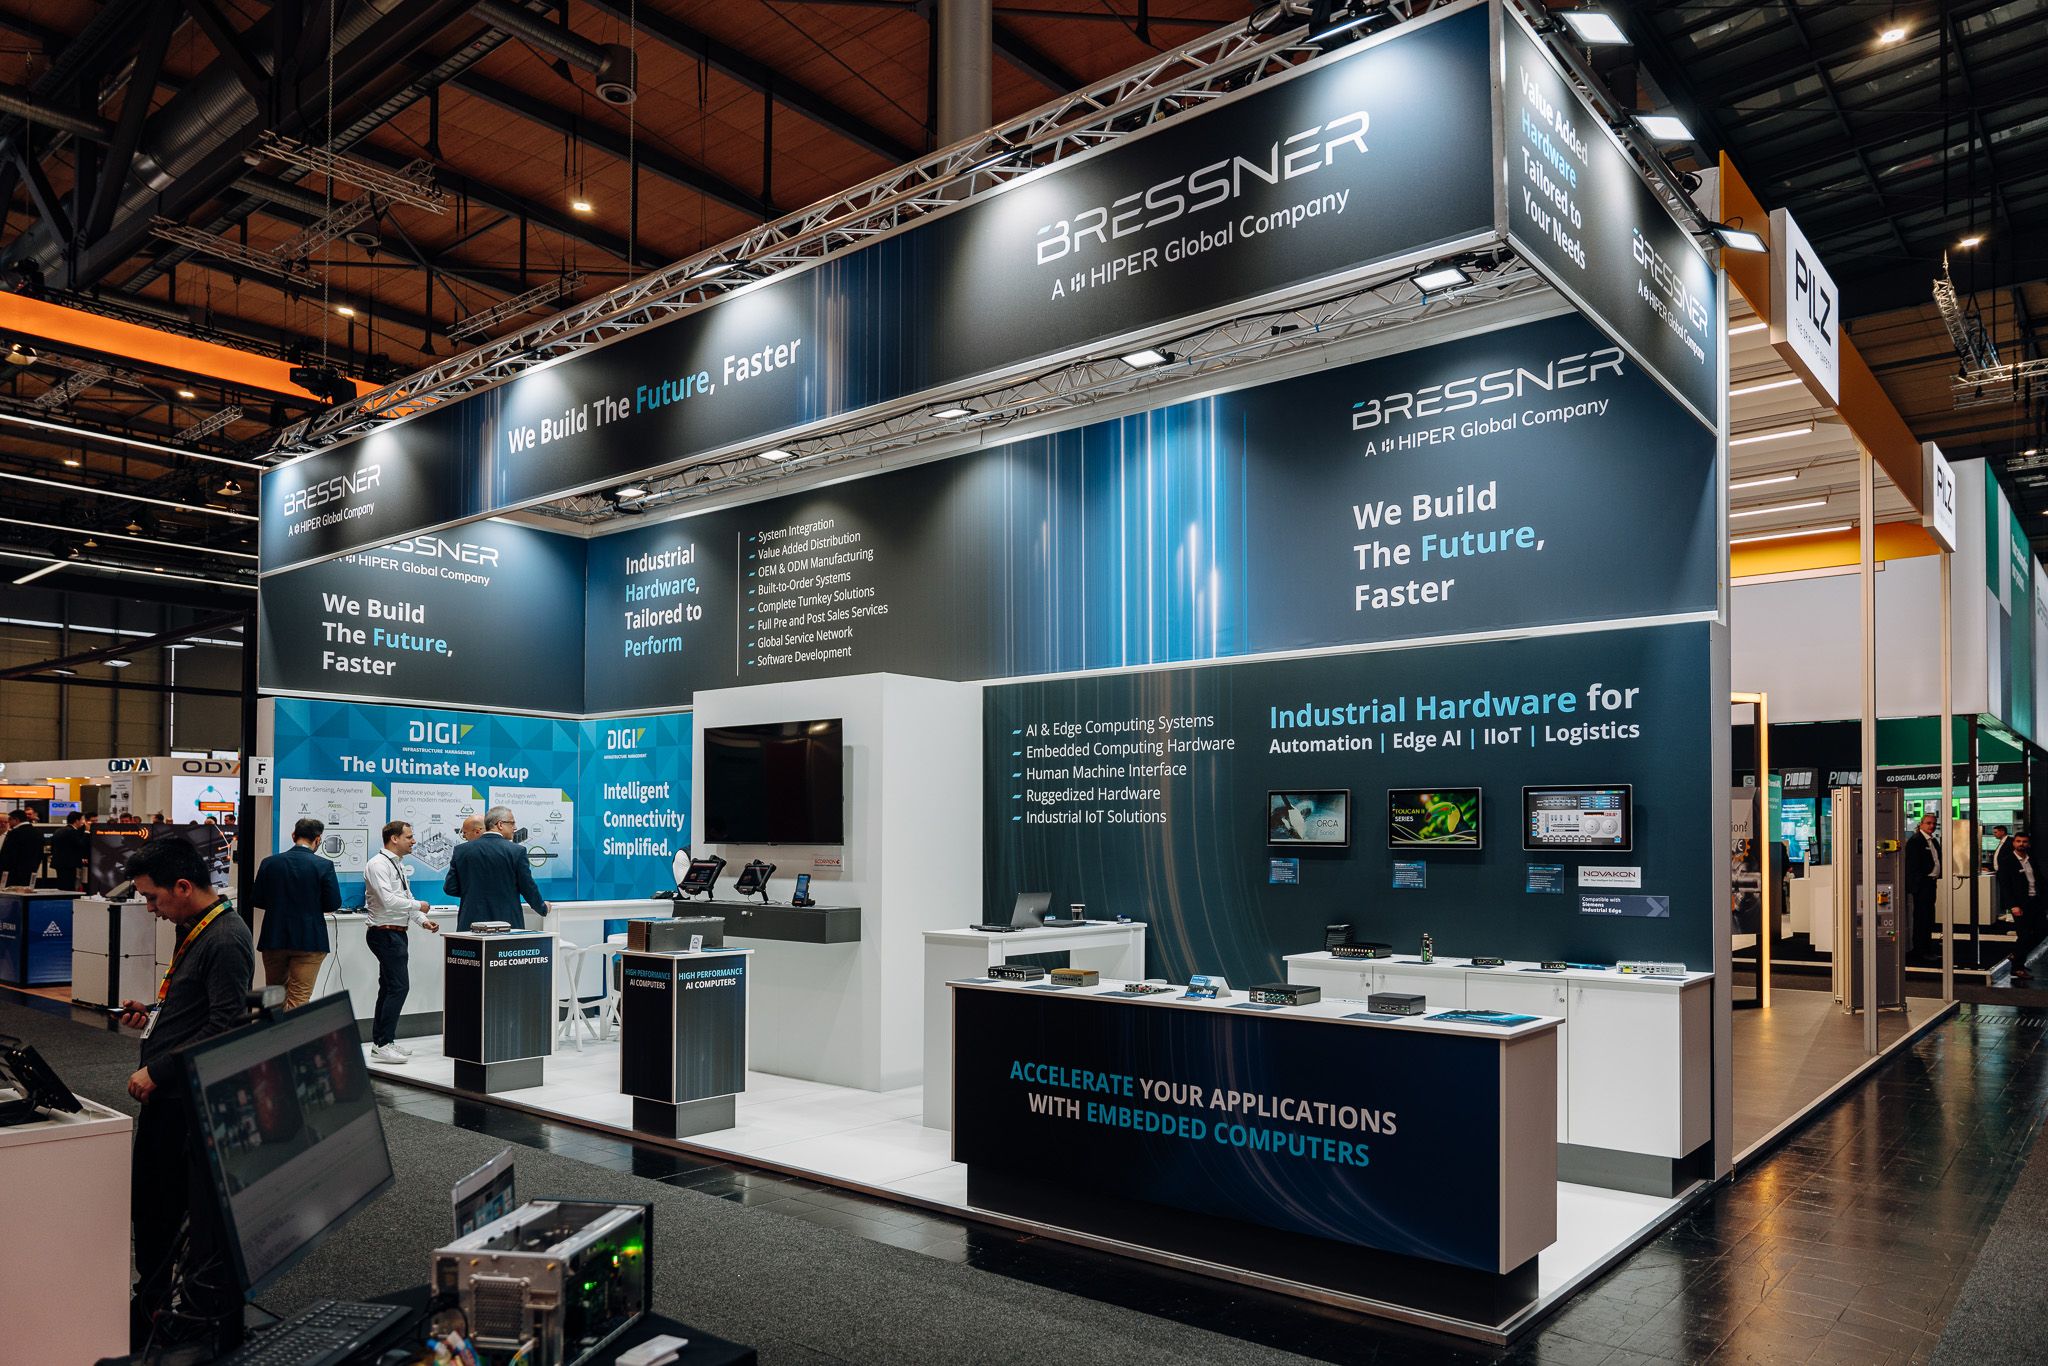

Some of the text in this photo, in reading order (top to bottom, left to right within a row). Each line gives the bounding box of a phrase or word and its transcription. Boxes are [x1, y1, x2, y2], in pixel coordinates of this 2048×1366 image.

[1520, 65, 1589, 168] Value Added
[1521, 107, 1577, 189] Hardware
[1037, 110, 1370, 266] BRESSNER
[1522, 146, 1582, 230] Tailored to
[1522, 185, 1586, 271] Your Needs
[1051, 188, 1350, 301] A HIPER Global Company
[1632, 226, 1708, 338] BRESSNER
[1795, 248, 1831, 346] PILZ
[1649, 288, 1705, 365] HIPER Global Company
[507, 337, 801, 454] We Build The Future, Faster
[1352, 346, 1625, 431] BRESSNER
[1365, 398, 1609, 457] A HIPER Global Company
[284, 464, 381, 517] BRESSNER
[1937, 464, 1952, 516] PILZ
[300, 502, 375, 534] HIPER Global Company
[1353, 481, 1497, 530] We Build
[758, 517, 835, 544] System Integration
[758, 530, 861, 560] Value Added Distribution
[1353, 524, 1545, 571] The Future,
[359, 554, 399, 570] HIPER
[402, 561, 438, 577] Global
[440, 567, 490, 587] Company
[626, 543, 695, 576] Industrial
[758, 547, 874, 578] OEM & ODM Manufacturing
[625, 575, 700, 603] Hardware,
[758, 571, 851, 595] Built-to-Order Systems
[1355, 577, 1455, 611] Faster
[322, 592, 425, 624] We Build
[758, 585, 875, 615] Complete Turnkey Solutions
[625, 602, 702, 630] Tailored to
[757, 603, 888, 631] Full Pre and Post Sales Services
[322, 621, 453, 657] The Future,
[625, 635, 682, 657] Perform
[757, 626, 853, 649] Global Service Network
[322, 651, 396, 676] Faster
[757, 646, 852, 667] Software Development
[1270, 682, 1640, 730] Industrial Hardware for
[409, 720, 457, 744] DIGI
[608, 728, 636, 749] DIGI
[1026, 713, 1214, 738] AI & Edge Computing Systems
[1269, 721, 1640, 754] Automation Edge AI IIoT Logistics
[1026, 736, 1235, 759] Embedded Computing Hardware
[108, 758, 151, 773] ODVA
[258, 763, 266, 775] F
[340, 756, 529, 783] The Ultimate Hookup
[1026, 761, 1187, 780] Human Machine Interface
[1918, 773, 1926, 781] GO
[288, 785, 311, 793] Smarter
[312, 785, 335, 794] Sensing,
[397, 789, 423, 797] Introduce
[604, 781, 670, 804] Intelligent
[1026, 786, 1161, 805] Ruggedized Hardware
[603, 809, 685, 832] Connectivity
[1026, 808, 1167, 824] Industrial IoT Solutions
[1316, 819, 1339, 828] ORCA
[603, 837, 672, 860] Simplified.
[452, 949, 476, 957] RUGGEDIZED
[457, 958, 480, 967] COMPUTERS
[498, 949, 540, 958] RUGGEDIZED
[508, 956, 549, 966] COMPUTERS
[636, 980, 665, 990] COMPUTERS
[637, 970, 671, 980] PERFORMANCE
[678, 967, 743, 980] HIGH PERFORMANCE
[686, 978, 736, 990] AI COMPUTERS
[1010, 1060, 1397, 1136] ACCELERATE YOUR APPLICATIONS
[1028, 1092, 1370, 1168] WITH EMBEDDED COMPUTERS
